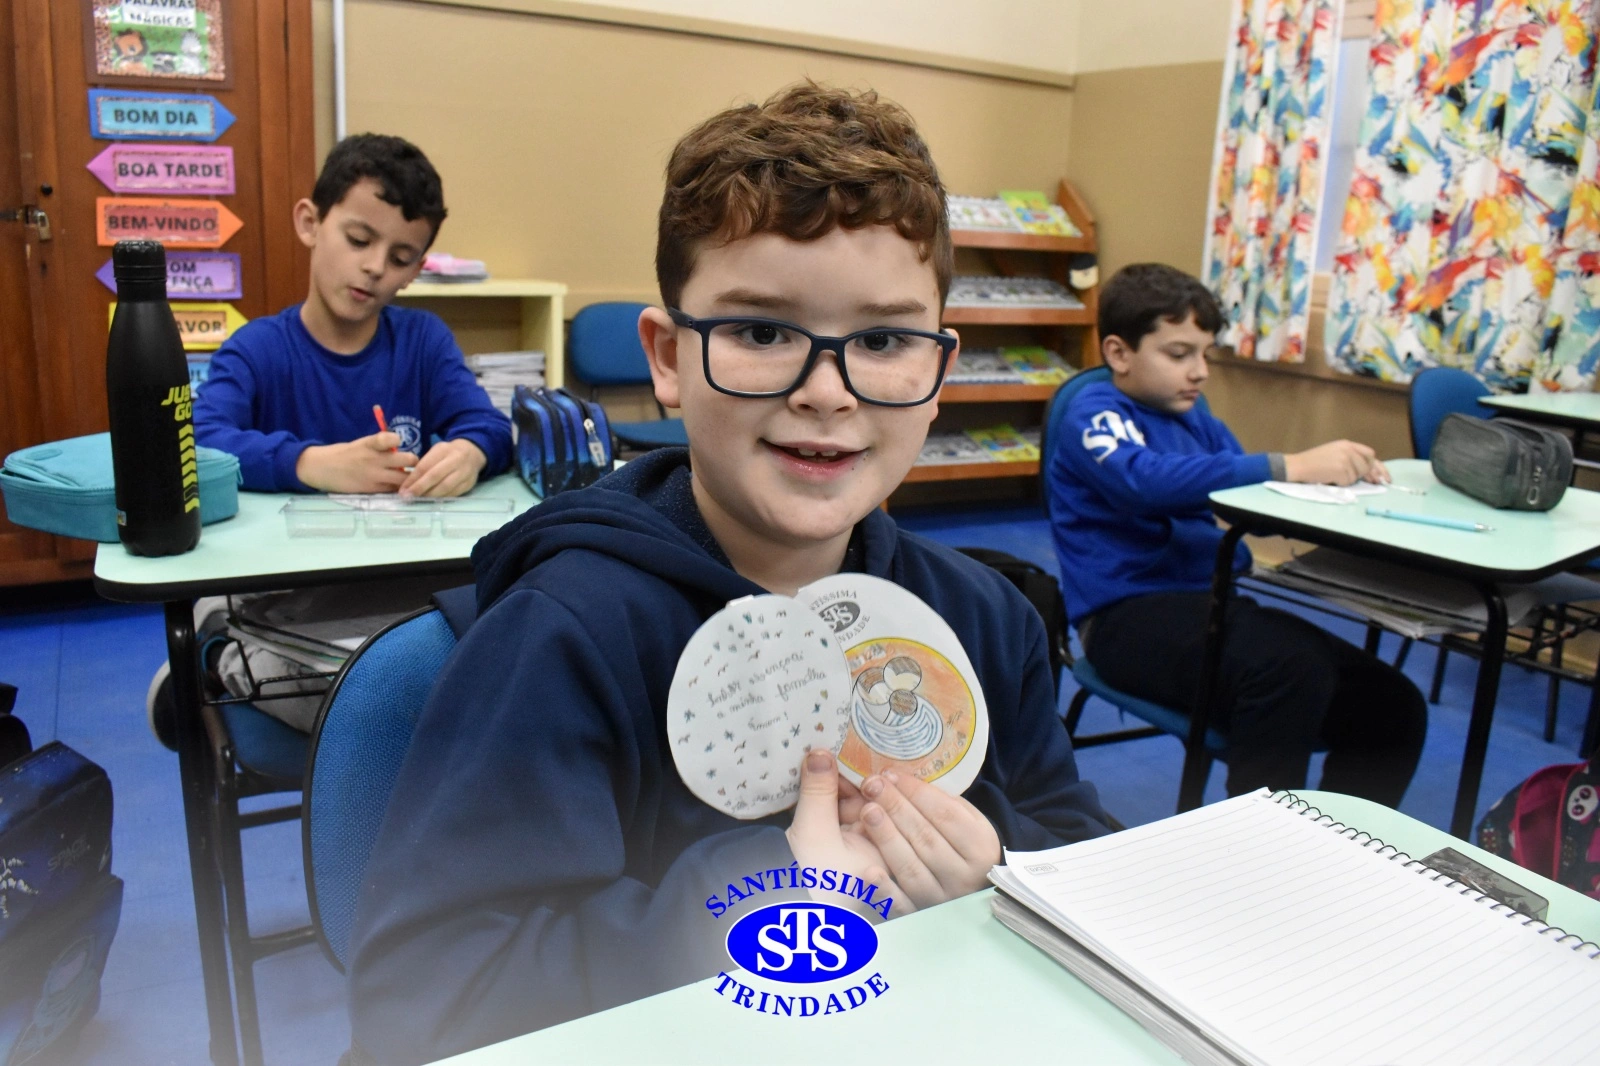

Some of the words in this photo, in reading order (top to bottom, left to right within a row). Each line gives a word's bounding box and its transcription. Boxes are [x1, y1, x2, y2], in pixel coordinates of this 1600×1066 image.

[114, 109, 159, 123] BOM
[165, 110, 198, 125] DIA
[118, 163, 158, 177] BOA
[164, 164, 223, 178] TARDE
[108, 215, 217, 231] BEM-VINDO
[170, 261, 196, 273] OM
[171, 275, 213, 289] ENÇA
[177, 319, 222, 333] AVOR
[161, 383, 191, 406] JUS
[174, 401, 192, 422] GO
[809, 589, 857, 611] NTÍSSIMA
[838, 614, 871, 643] NDADE
